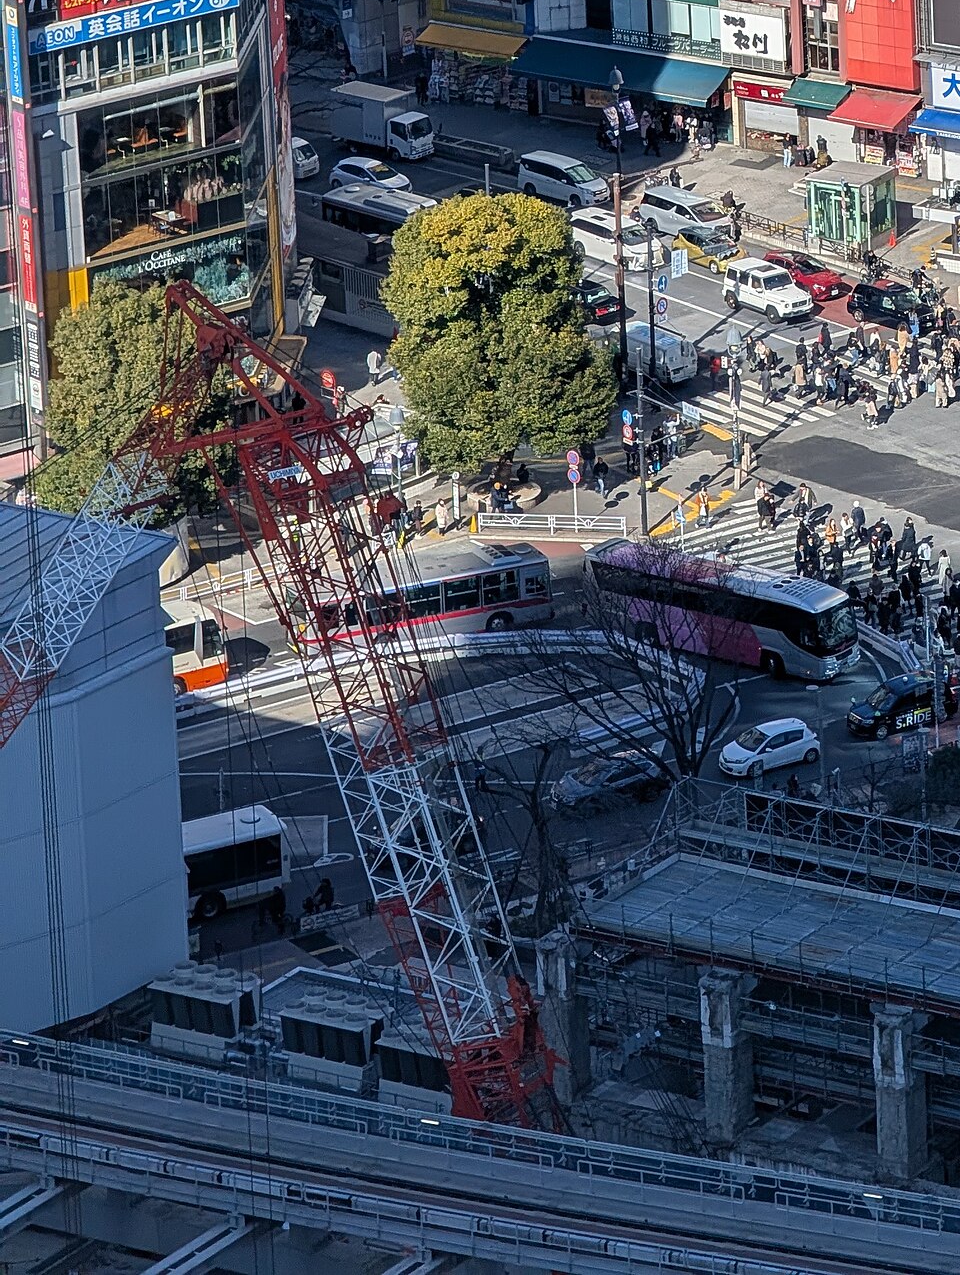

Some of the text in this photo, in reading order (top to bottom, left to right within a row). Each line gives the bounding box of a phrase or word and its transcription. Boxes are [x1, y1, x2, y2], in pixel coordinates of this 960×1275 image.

[37, 25, 75, 49] AEON
[615, 33, 649, 46] 渋谷西村
[138, 254, 185, 273] L'OCCITANE
[895, 710, 932, 730] S.RIDE
